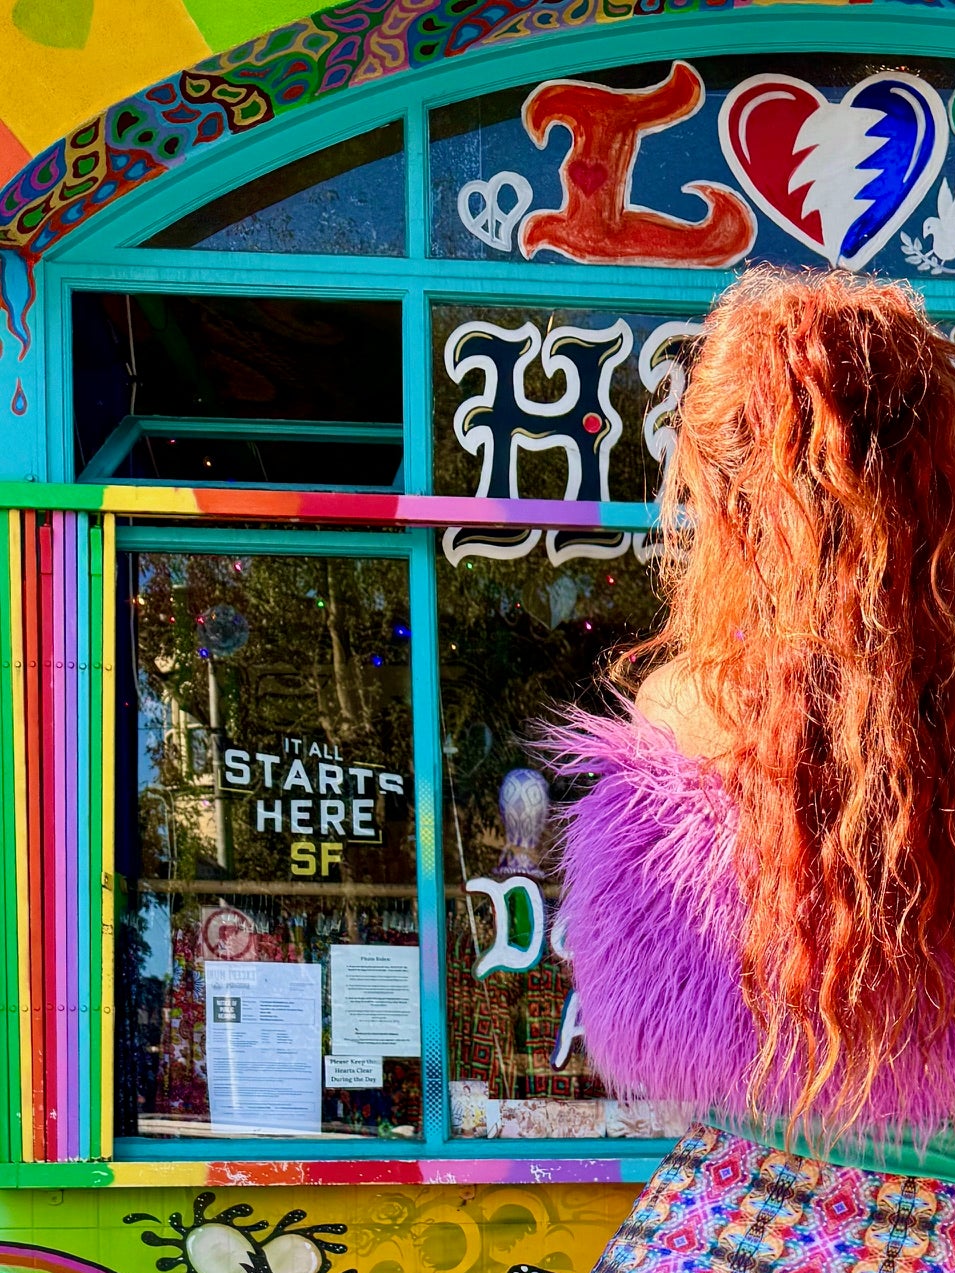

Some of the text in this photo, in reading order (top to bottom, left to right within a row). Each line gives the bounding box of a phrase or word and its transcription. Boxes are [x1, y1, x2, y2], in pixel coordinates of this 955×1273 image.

[284, 737, 344, 762] IT ALL
[224, 748, 404, 795] STARTS
[256, 799, 376, 837] HERE
[290, 841, 344, 877] SF
